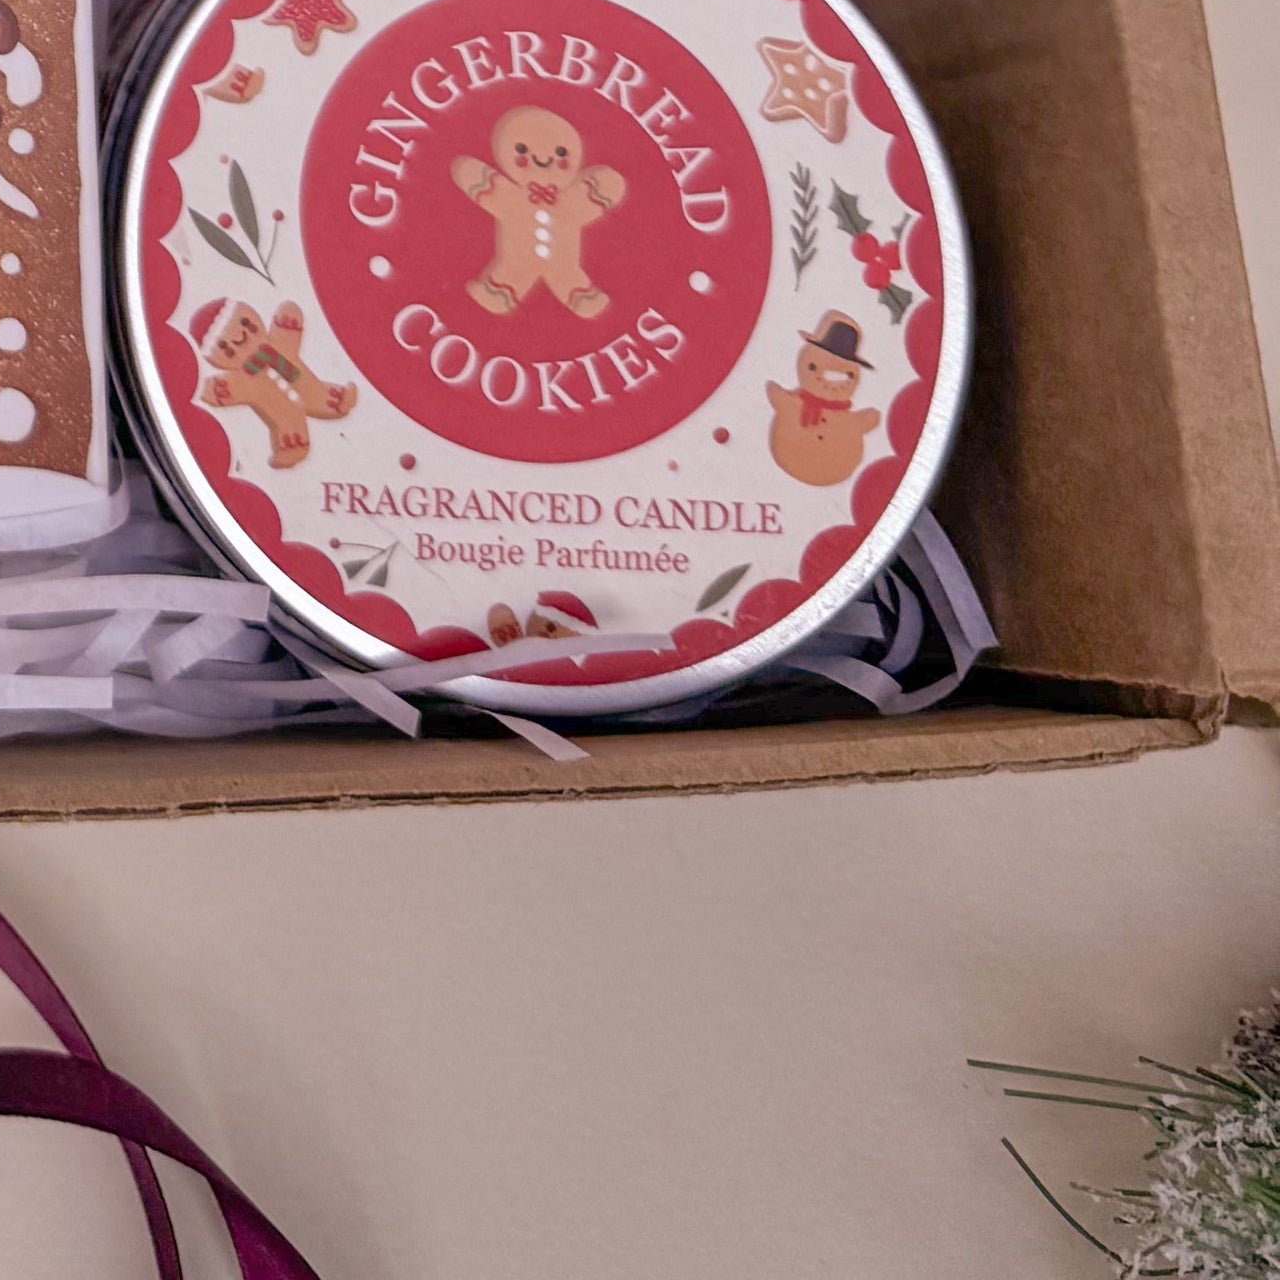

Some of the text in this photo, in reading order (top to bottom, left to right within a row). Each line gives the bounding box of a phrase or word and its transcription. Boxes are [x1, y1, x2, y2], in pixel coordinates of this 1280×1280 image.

[348, 30, 732, 234] GINGERBREAD
[391, 303, 687, 413] COOKIES
[319, 481, 784, 535] FRAGRANCED CANDLE
[413, 532, 691, 574] Bougie Parfumée
